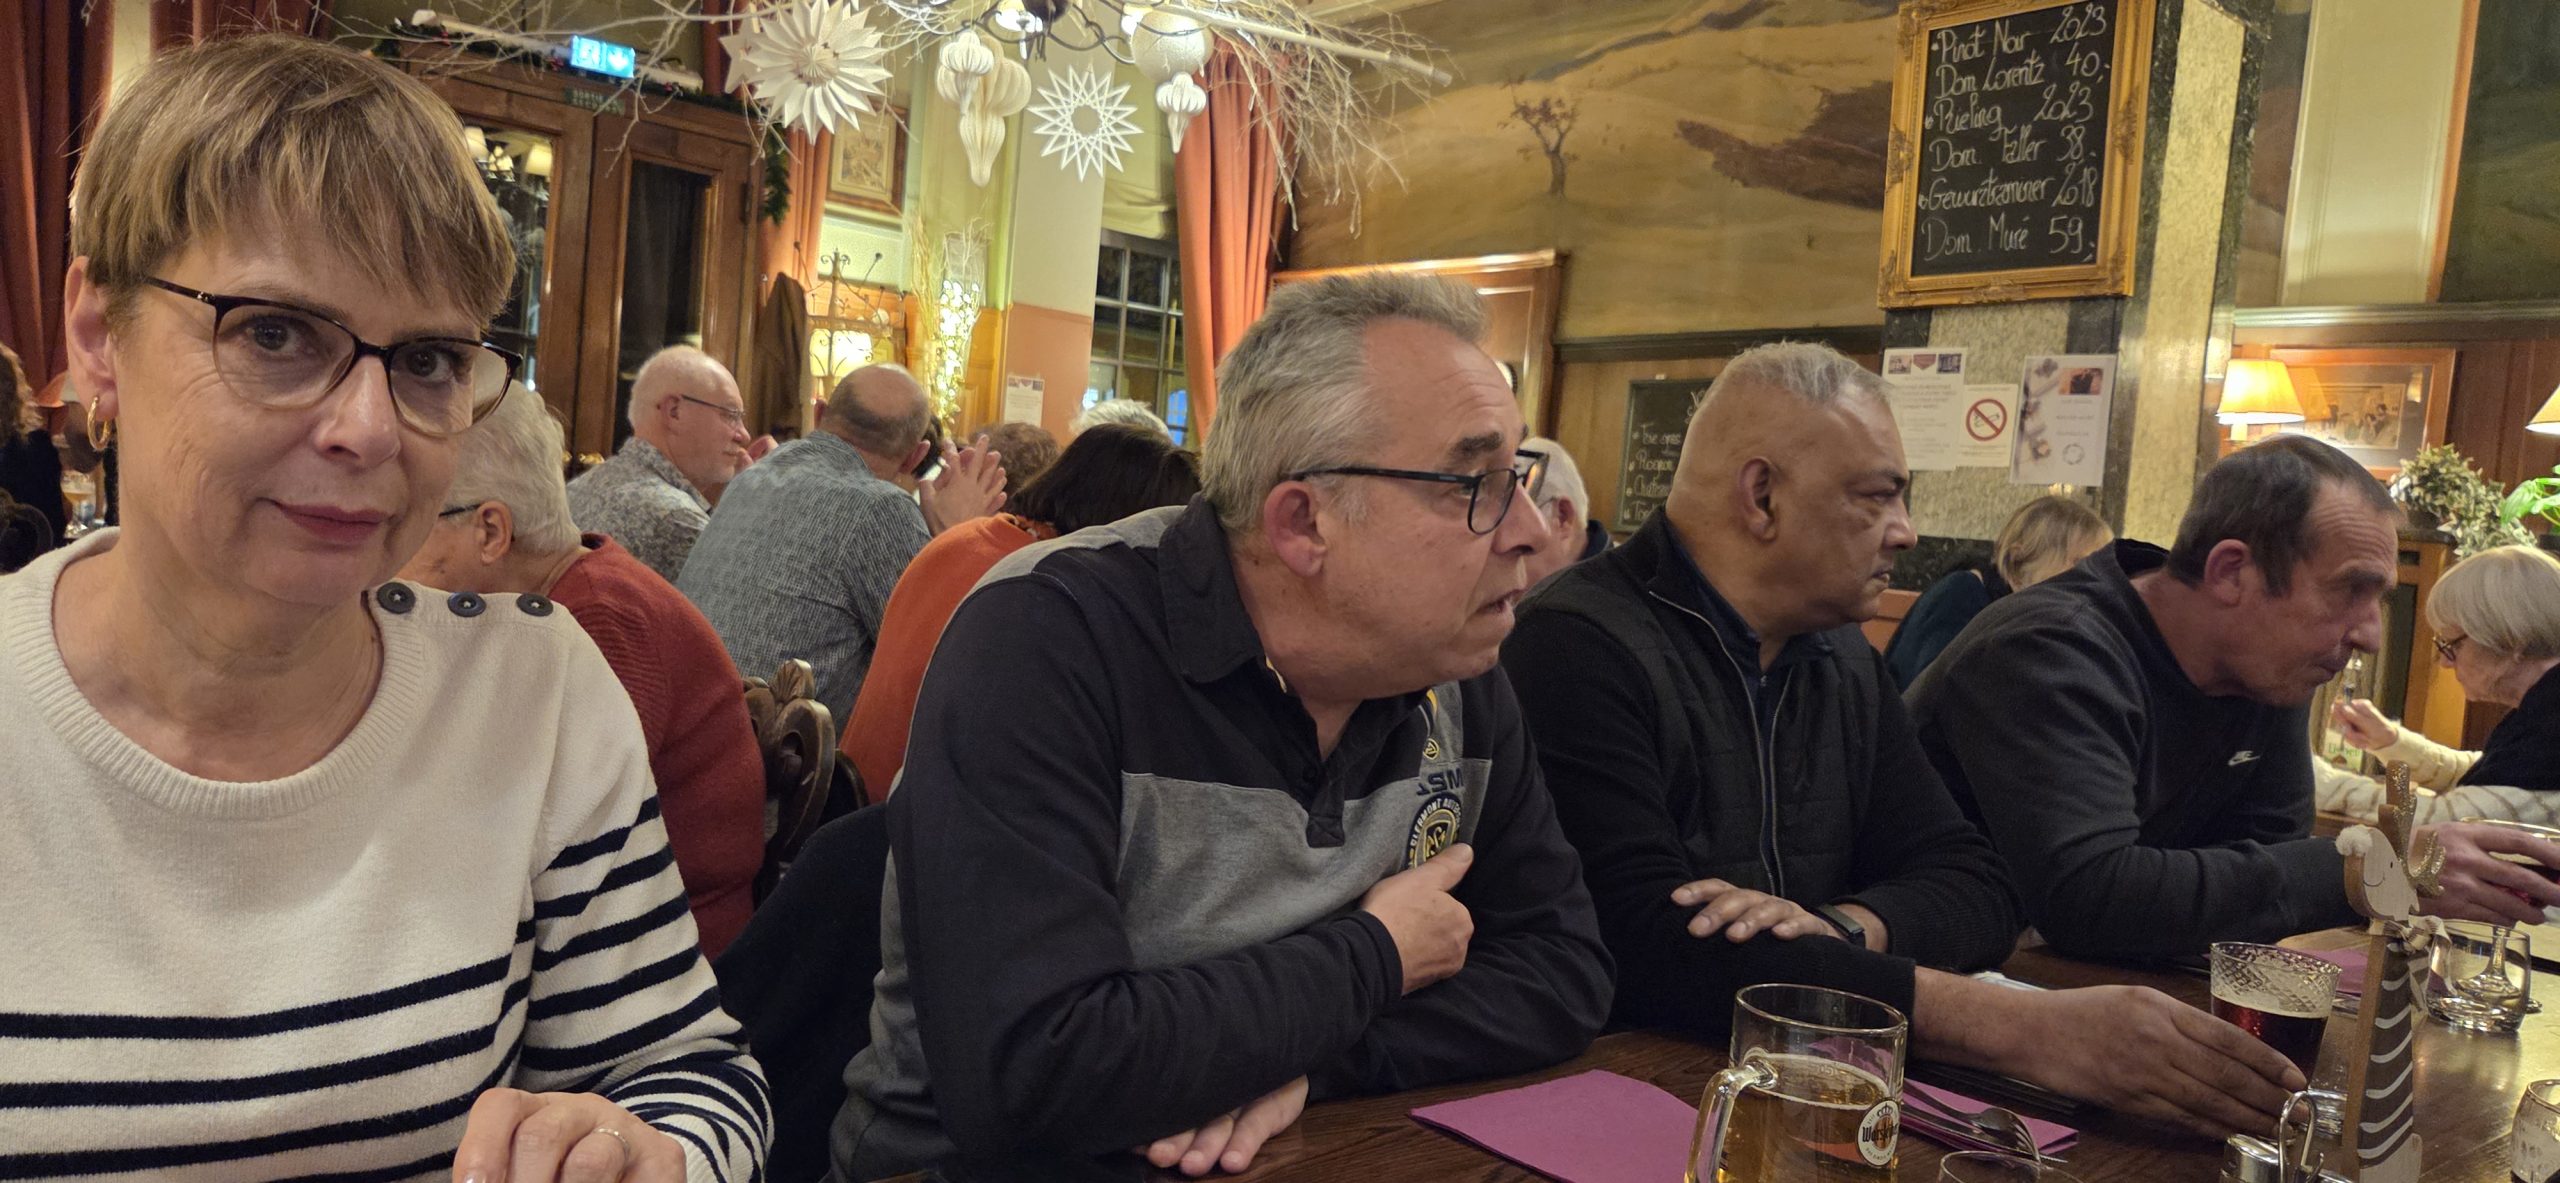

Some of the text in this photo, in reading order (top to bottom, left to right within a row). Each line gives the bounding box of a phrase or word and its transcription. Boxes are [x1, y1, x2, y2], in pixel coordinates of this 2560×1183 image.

[1936, 3, 2107, 63] Pinot Noir 2023
[1982, 48, 2045, 91] Lorentz
[2033, 81, 2093, 123] 2023
[2051, 162, 2097, 207] 2018
[1988, 212, 2029, 251] Muré
